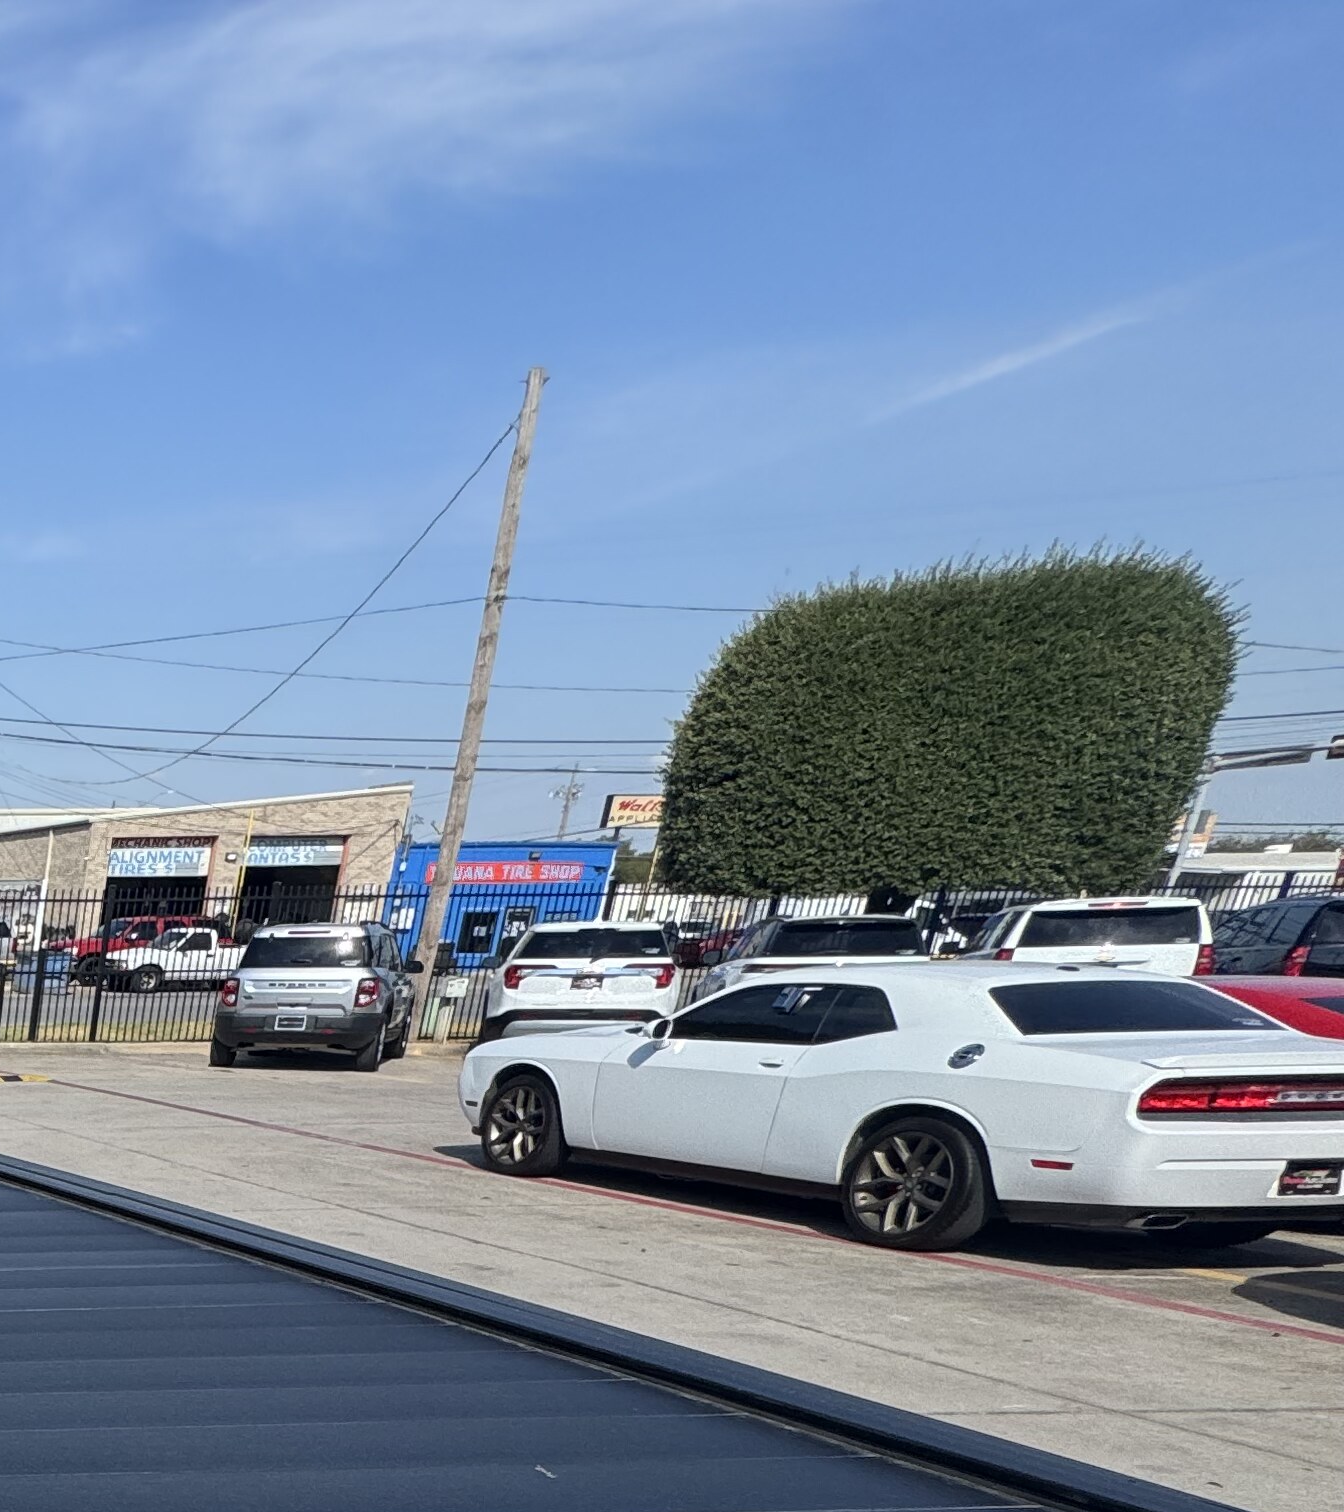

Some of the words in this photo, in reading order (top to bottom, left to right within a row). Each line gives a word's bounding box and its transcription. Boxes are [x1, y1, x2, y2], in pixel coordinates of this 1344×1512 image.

[176, 837, 211, 847] SHOP
[110, 850, 205, 864] ALIGNMENT
[109, 864, 158, 875] TIRES
[502, 864, 533, 880] TIRE
[540, 864, 581, 880] SHOP
